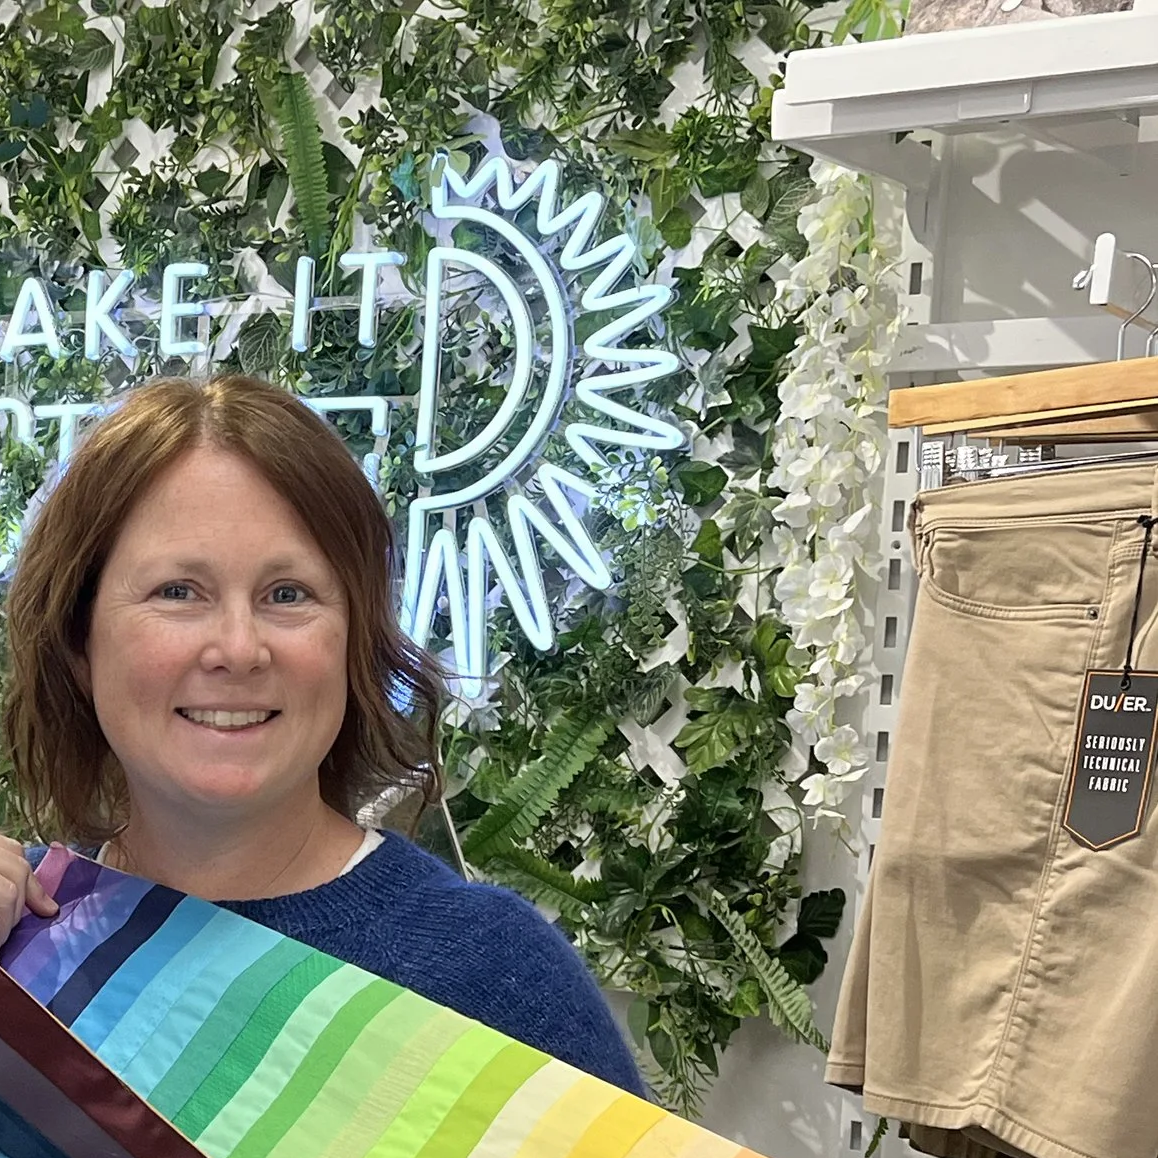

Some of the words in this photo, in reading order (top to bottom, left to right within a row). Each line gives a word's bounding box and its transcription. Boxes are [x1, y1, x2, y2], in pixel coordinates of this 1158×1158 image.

[291, 251, 407, 353] IT
[1085, 735, 1146, 752] SERIOUSLY
[1083, 755, 1141, 773] TECHNICAL
[1088, 776, 1129, 792] FABRIC
